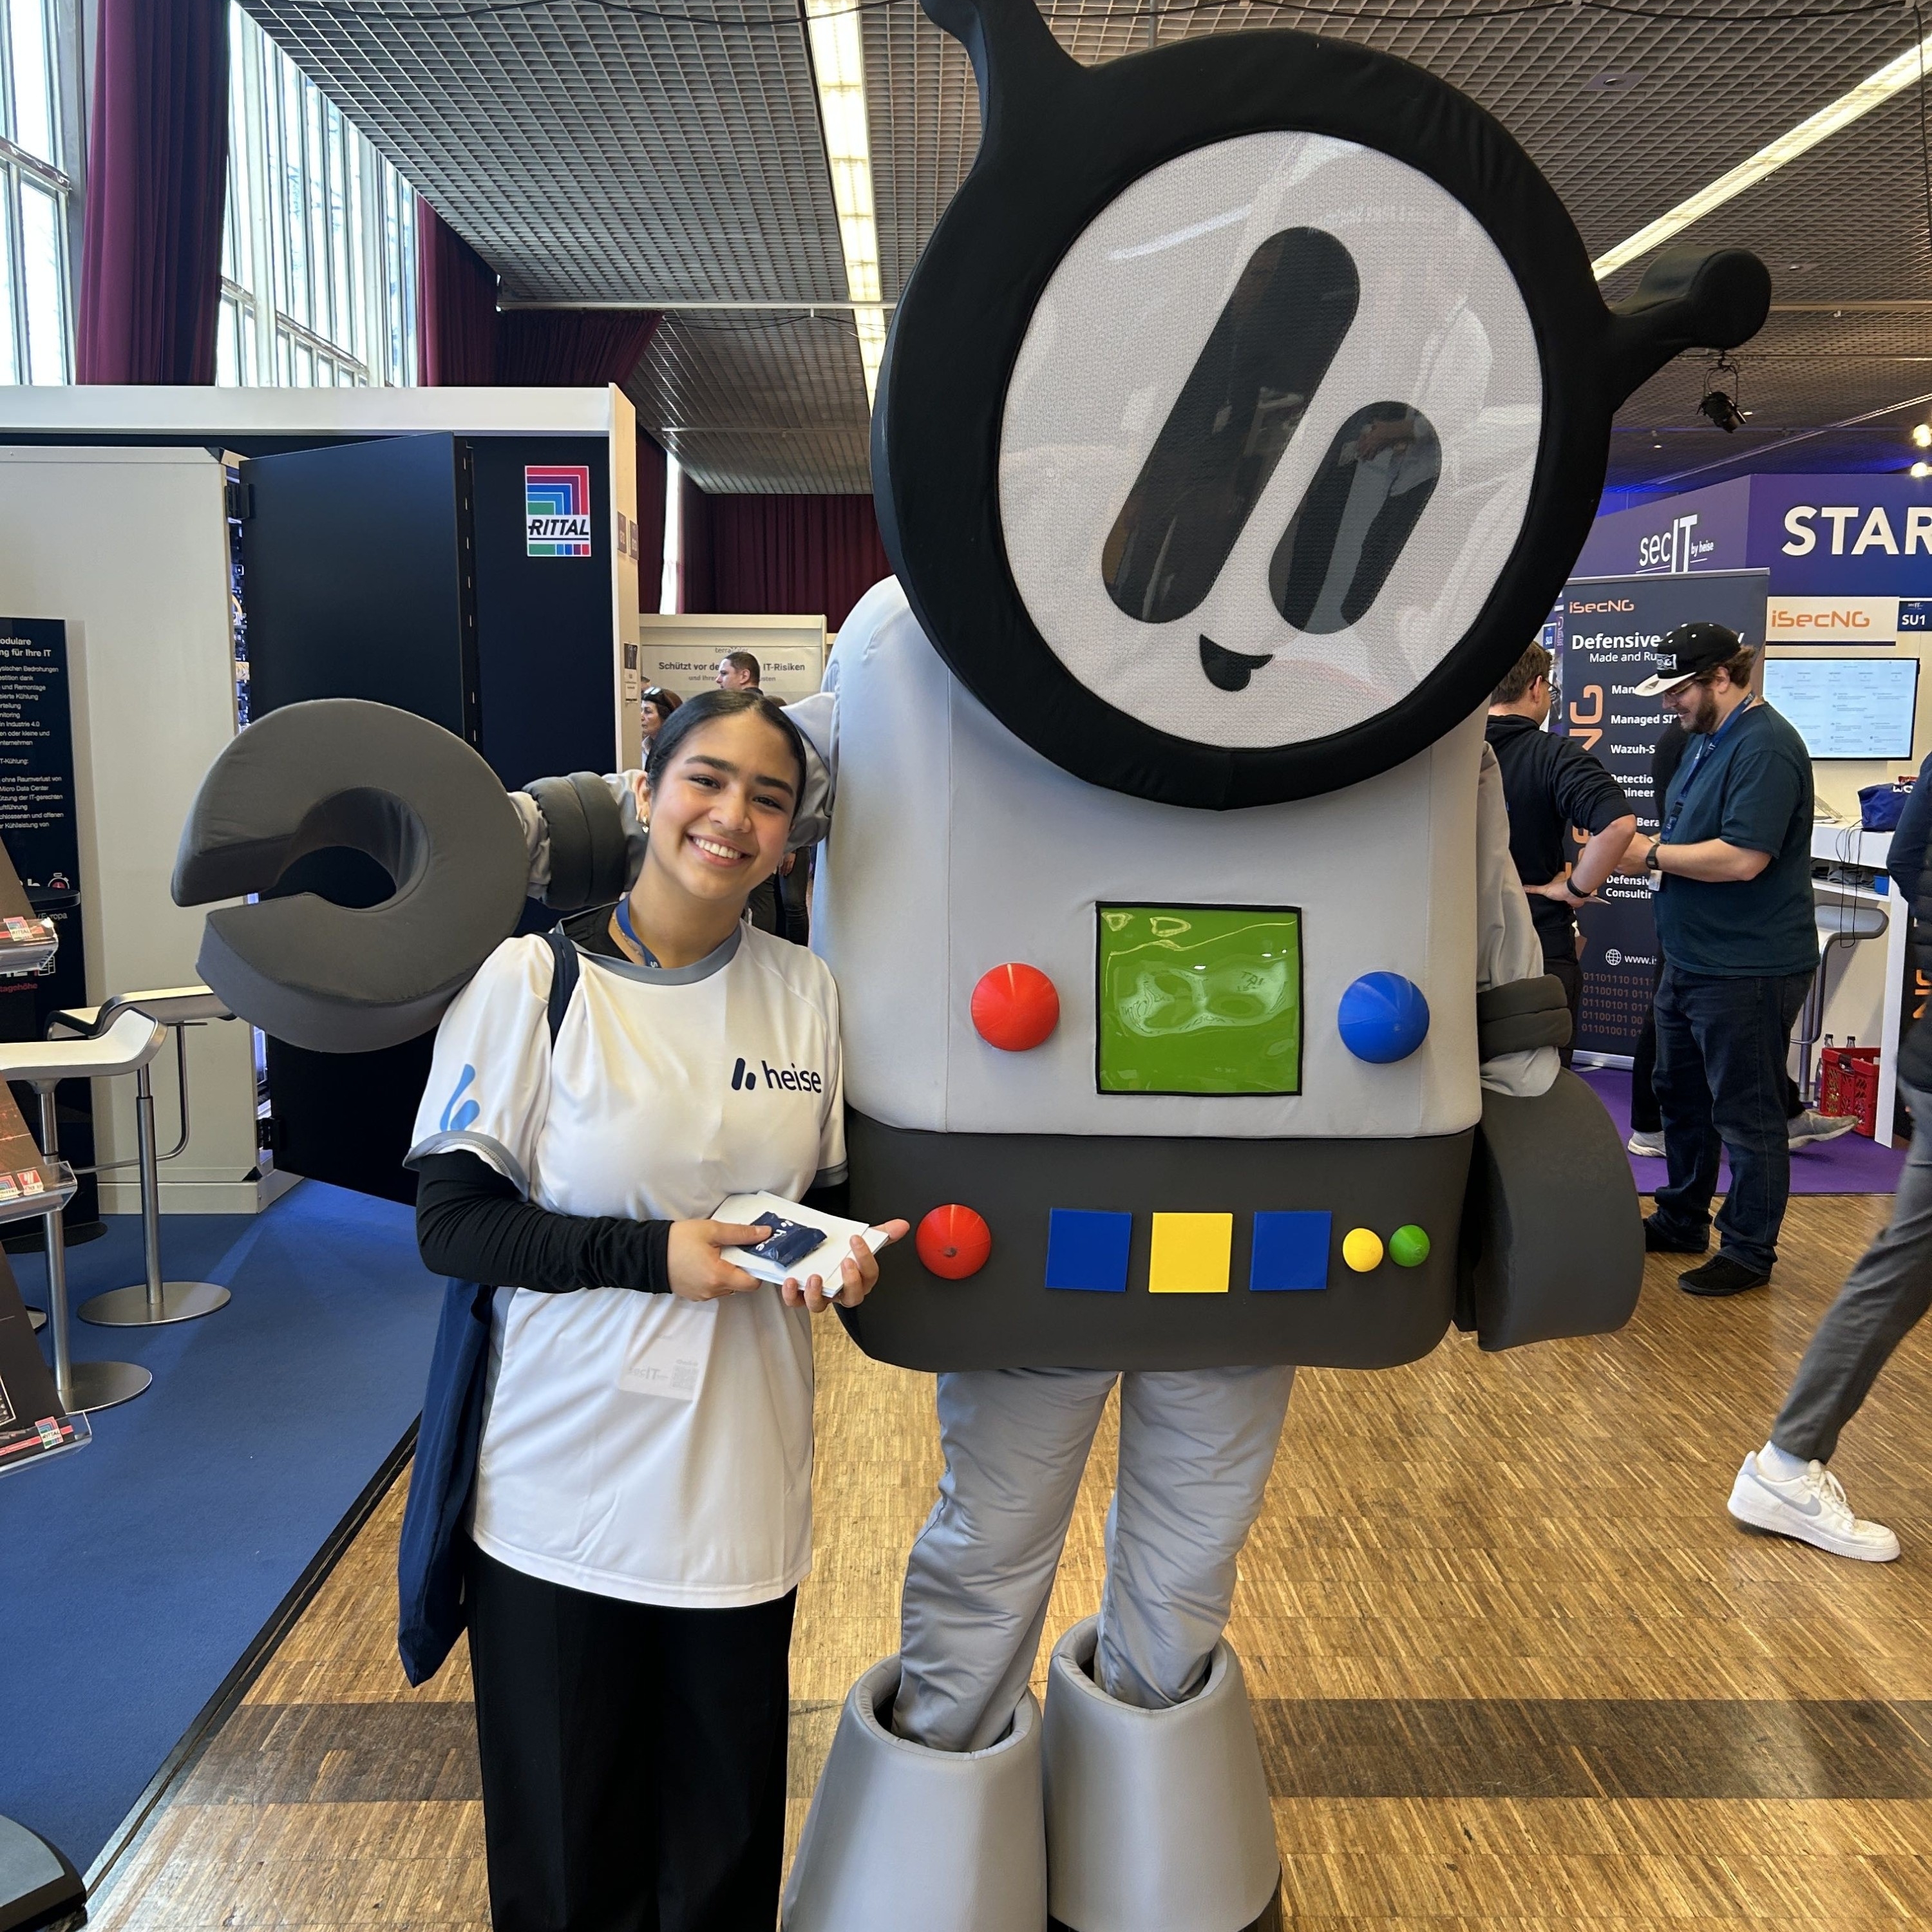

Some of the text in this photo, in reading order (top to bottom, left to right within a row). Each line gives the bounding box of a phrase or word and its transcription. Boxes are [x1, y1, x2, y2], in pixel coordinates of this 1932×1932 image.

[528, 519, 589, 535] RITTAL
[1782, 506, 1932, 556] STAR
[1690, 542, 1698, 557] by
[1700, 540, 1714, 553] heise
[1569, 600, 1635, 613] iSecNG
[1772, 611, 1870, 627] iSecNG
[1902, 614, 1926, 625] SU1
[0, 637, 32, 645] odulare
[1572, 632, 1661, 650] Defensive
[1590, 652, 1618, 663] Made
[1621, 652, 1642, 662] and
[659, 661, 692, 670] Schützt
[763, 662, 806, 671] IT-Risiken
[1611, 714, 1660, 726] Managed
[1611, 744, 1656, 754] Wazuh-S
[1636, 817, 1660, 827] Bera
[761, 1061, 822, 1093] heise
